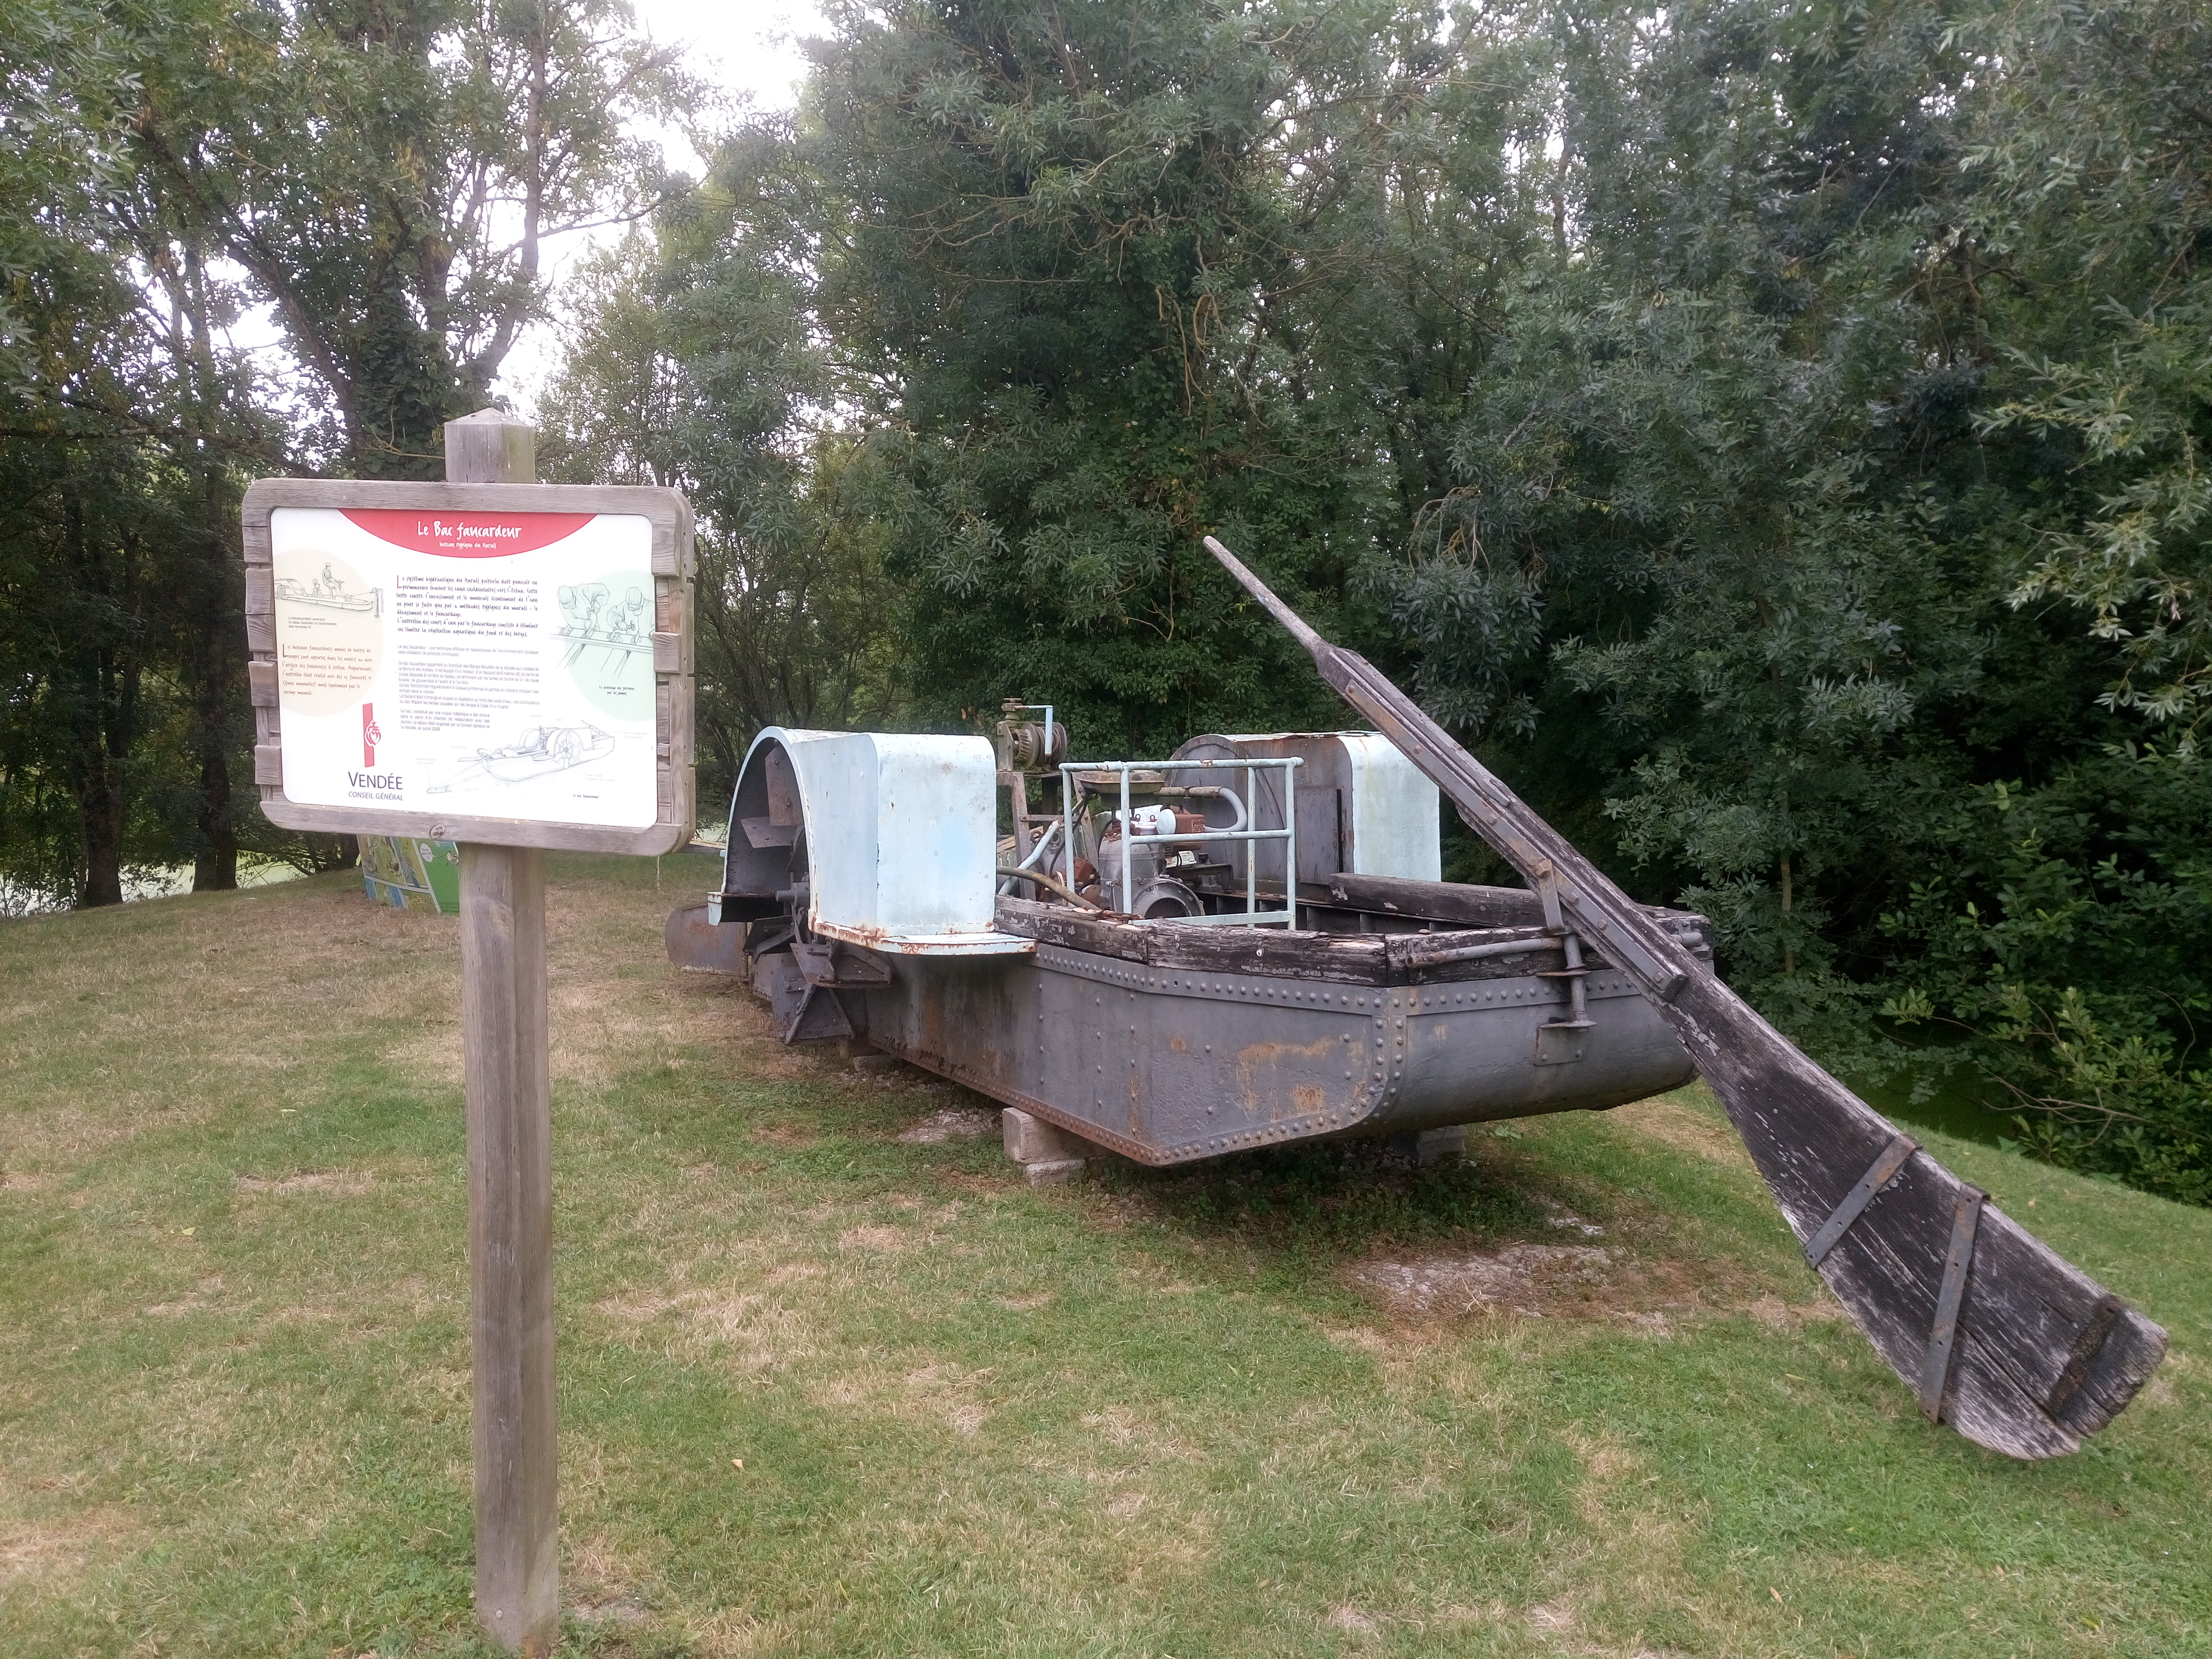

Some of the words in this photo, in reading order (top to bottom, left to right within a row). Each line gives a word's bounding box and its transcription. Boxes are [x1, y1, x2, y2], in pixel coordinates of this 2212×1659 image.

[418, 521, 429, 536] Le
[433, 521, 453, 536] Bac
[456, 522, 522, 540] faucardeur
[348, 772, 403, 790] VENDÉE
[375, 792, 404, 801] GÉNÉRAL
